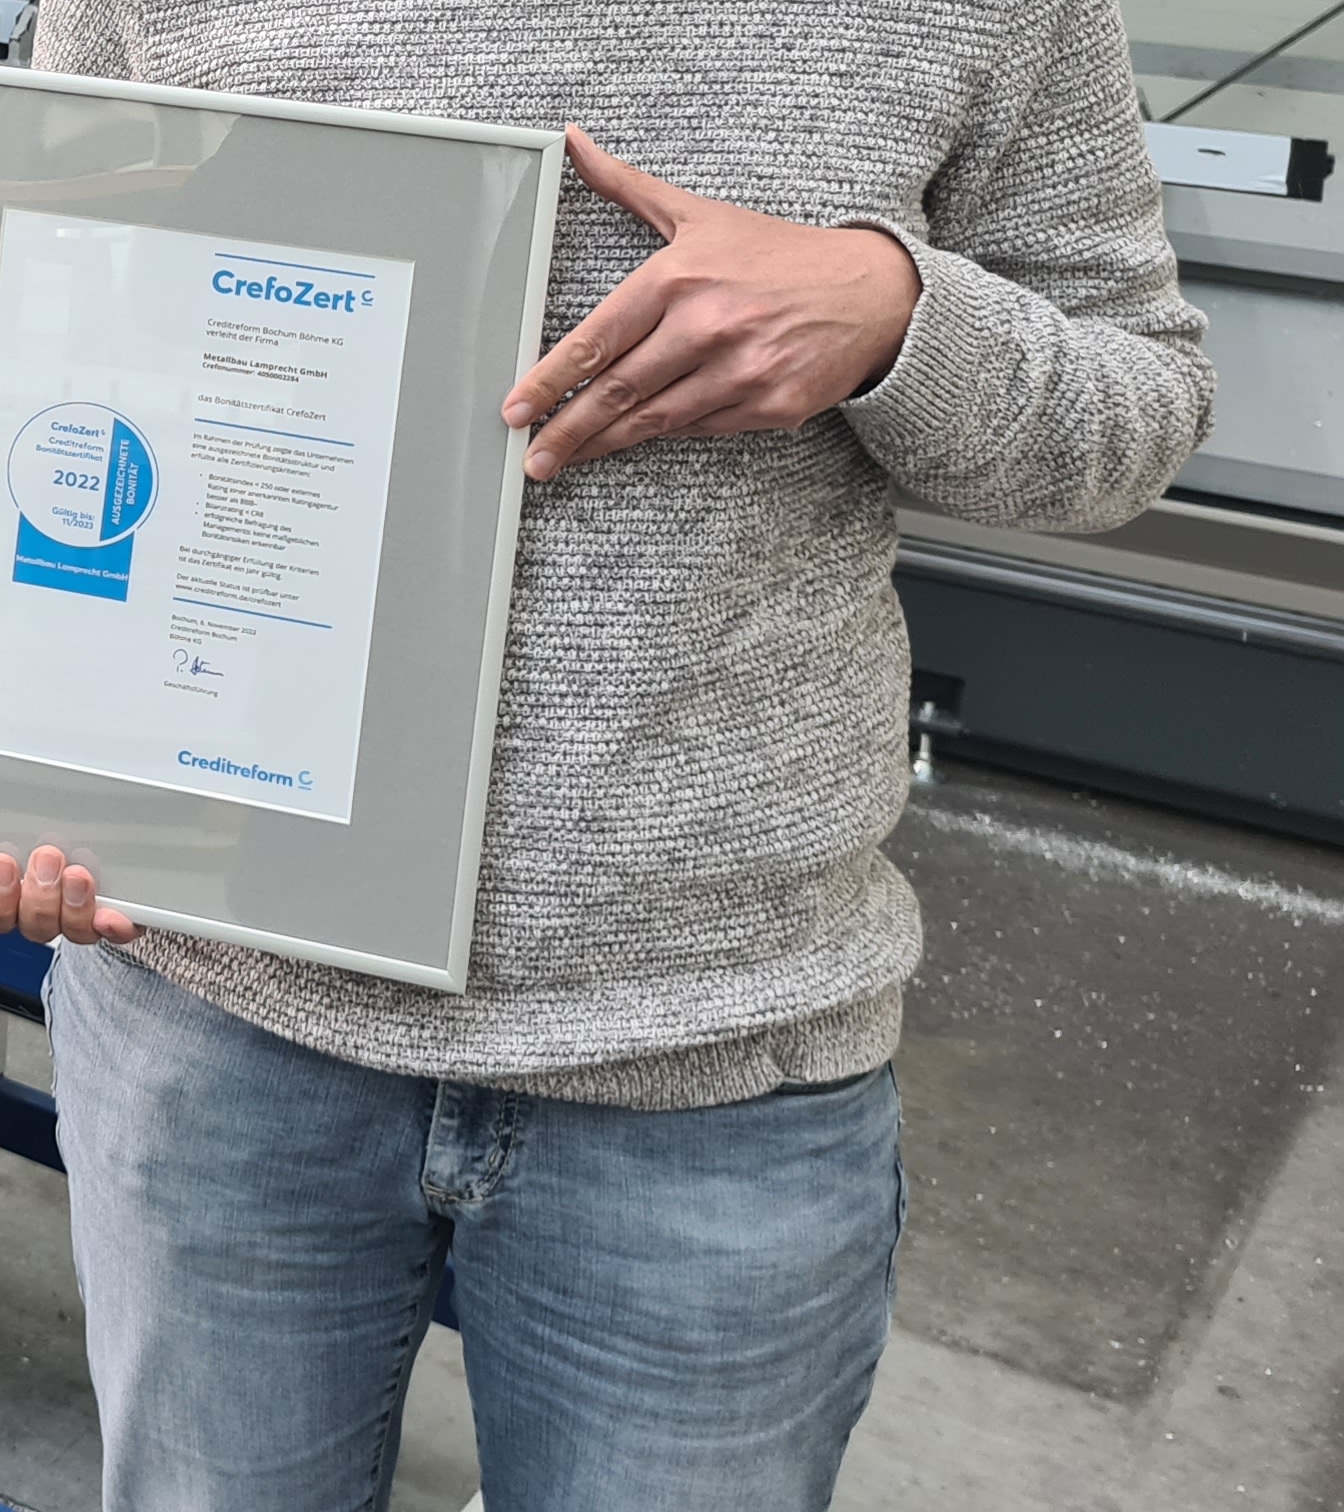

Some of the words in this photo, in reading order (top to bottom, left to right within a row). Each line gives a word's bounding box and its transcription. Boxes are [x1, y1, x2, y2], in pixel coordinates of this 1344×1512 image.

[212, 269, 356, 313] CrefoZert
[206, 330, 238, 340] verleiht
[238, 333, 254, 342] der
[254, 335, 279, 347] Firma
[207, 318, 261, 333] Creditreform
[262, 326, 297, 339] Bochum
[331, 337, 344, 346] KG
[203, 352, 248, 366] Metallbau
[249, 360, 298, 374] Lamprecht
[299, 367, 328, 379] GmbH
[197, 394, 213, 403] das
[214, 396, 284, 415] Bonitätszertifikat
[286, 408, 326, 422] CrefoZert
[203, 434, 231, 444] Rahmen
[231, 439, 244, 447] der
[293, 449, 306, 457] das
[306, 451, 355, 465] Unternehmen
[53, 469, 100, 491] 2022
[110, 438, 131, 526] AUSGEZEICHNETE
[125, 462, 140, 506] BONITÄT
[279, 525, 292, 533] des
[187, 557, 201, 565] das
[289, 565, 320, 576] Kriterien
[176, 572, 190, 581] Der
[177, 750, 293, 787] Creditreform
